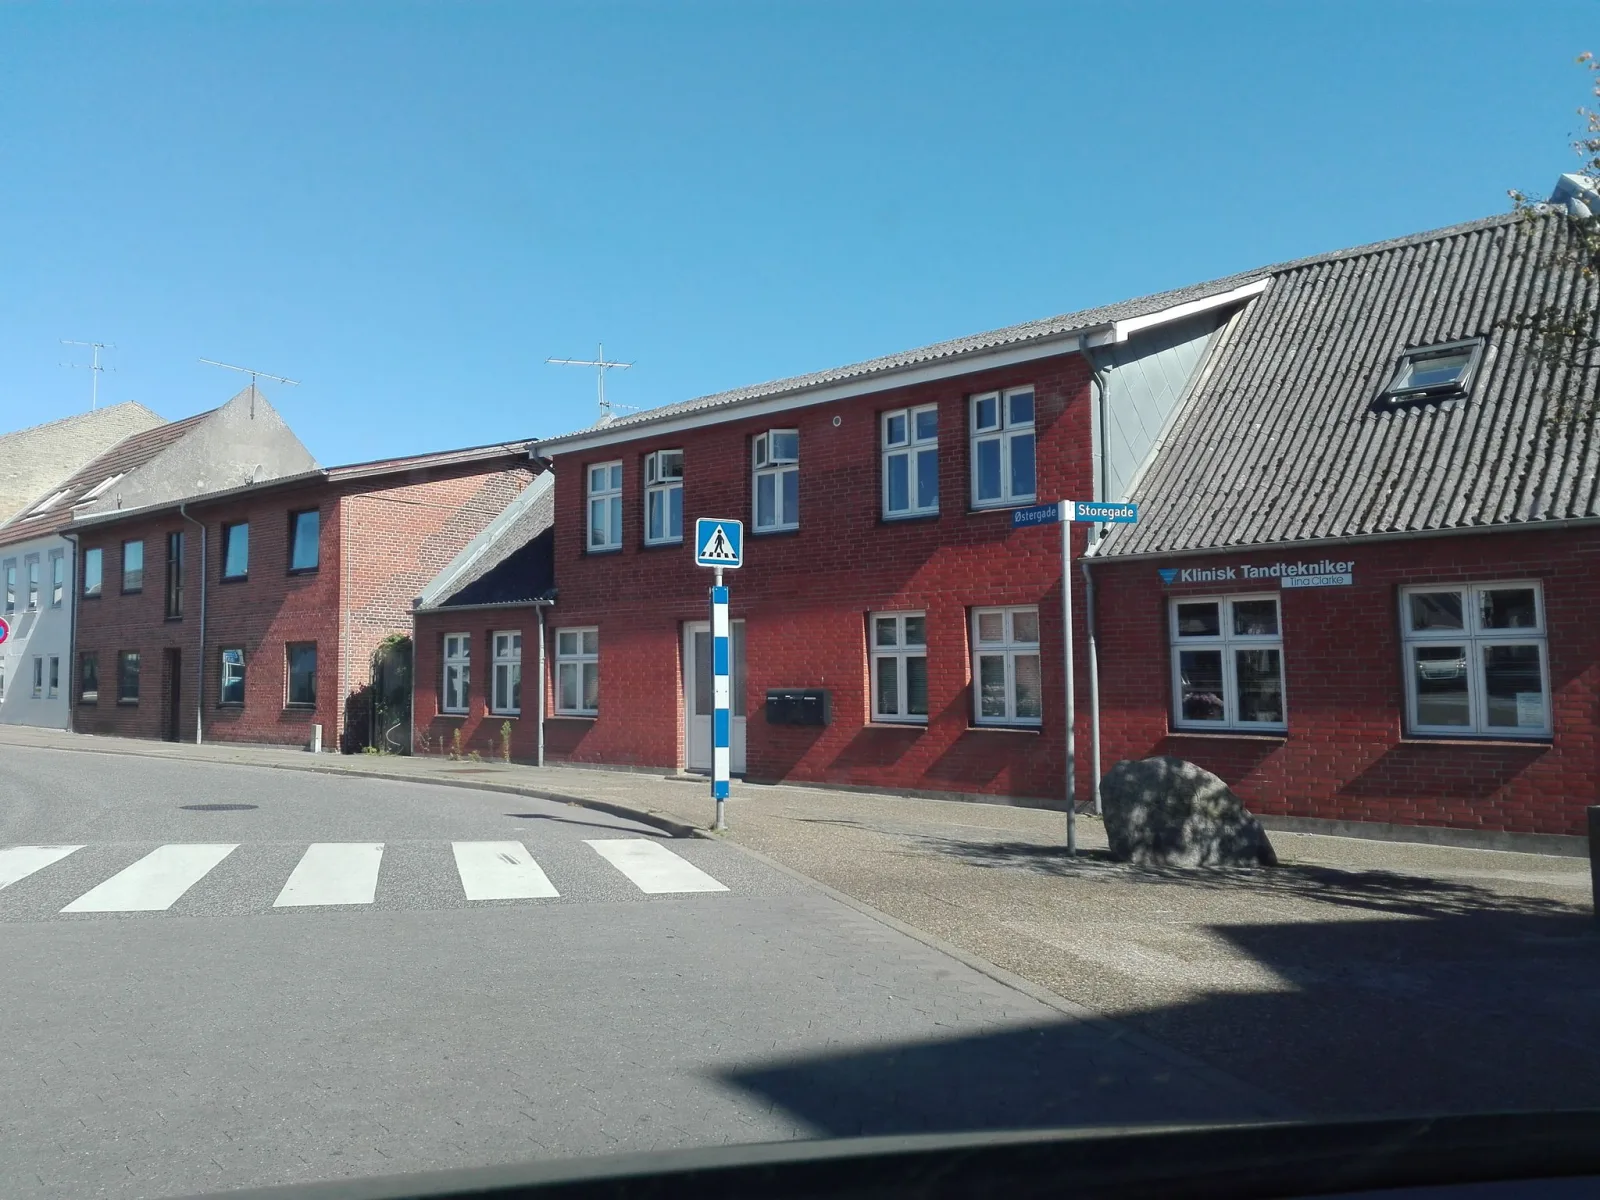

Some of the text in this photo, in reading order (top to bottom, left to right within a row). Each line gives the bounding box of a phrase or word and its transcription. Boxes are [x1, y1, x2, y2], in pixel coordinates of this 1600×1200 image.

[1015, 506, 1056, 522] Østergade
[1078, 504, 1134, 519] Storegade
[1181, 560, 1355, 582] Klinisk Tandtekniker
[1290, 575, 1344, 586] Tina Clarke
